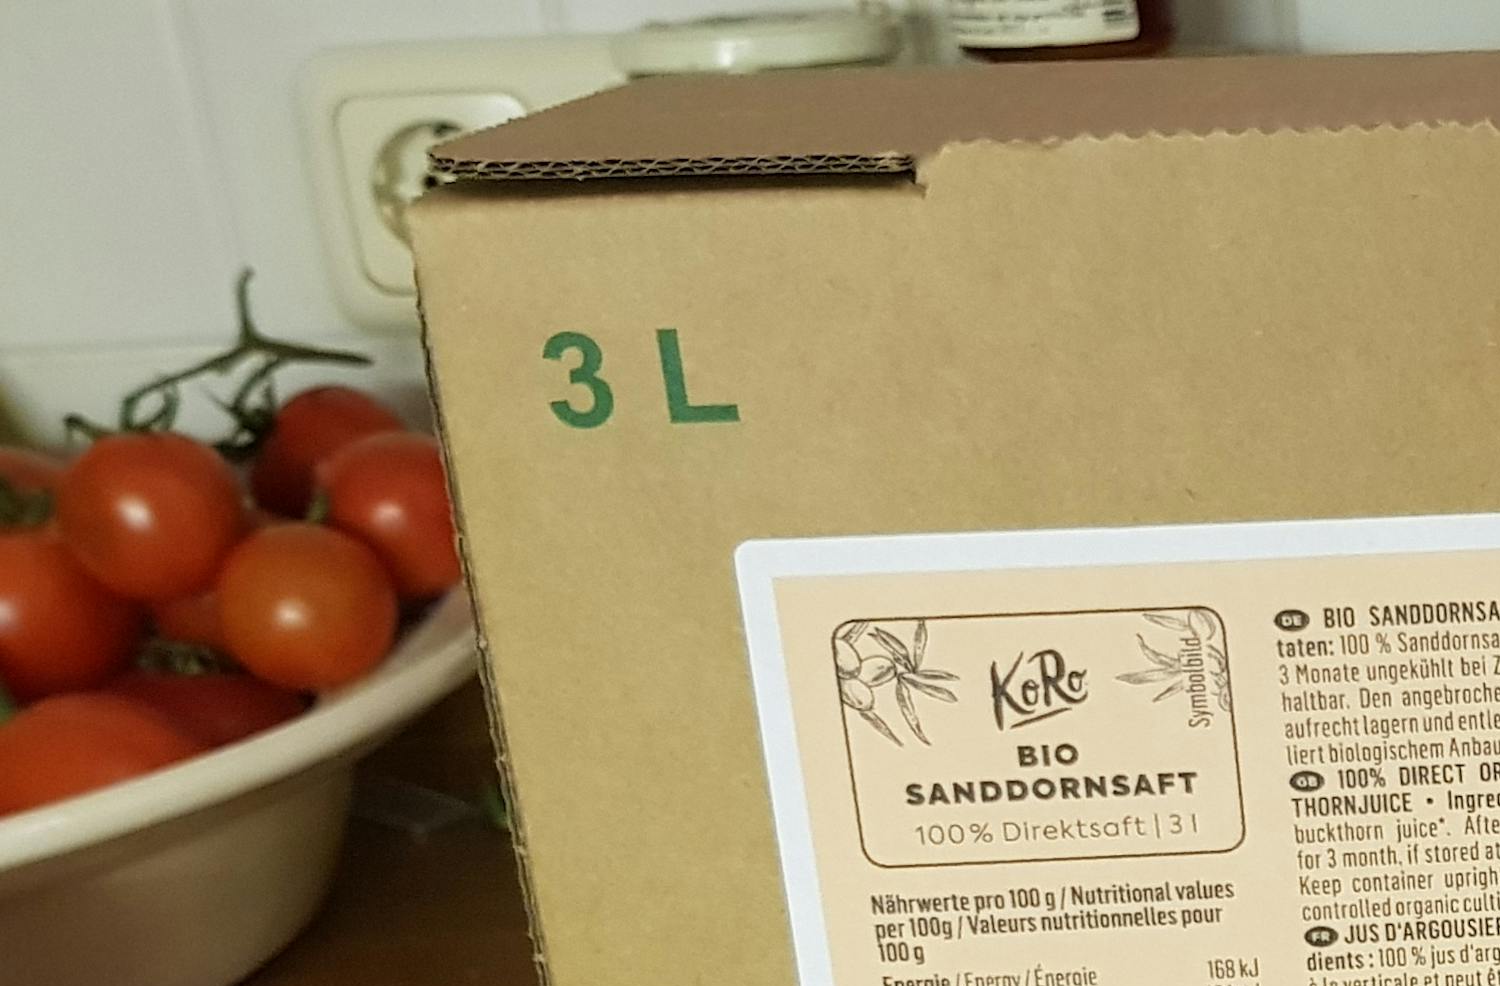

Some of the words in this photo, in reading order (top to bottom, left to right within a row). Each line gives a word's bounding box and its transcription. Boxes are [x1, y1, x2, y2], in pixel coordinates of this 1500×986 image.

[542, 331, 614, 429] 3
[656, 328, 741, 423] L
[1323, 606, 1355, 629] BIO
[1276, 638, 1335, 658] taten:
[1180, 636, 1212, 728] Symbolbild
[1295, 663, 1360, 685] Monate
[1366, 657, 1454, 685] ungekühlt
[1460, 655, 1486, 677] bei
[989, 648, 1089, 732] KoRo
[1281, 690, 1350, 712] haltbar.
[1359, 687, 1392, 709] Den
[1285, 716, 1360, 739] aufrecht
[1362, 714, 1419, 739] lagern
[1422, 710, 1454, 733] und
[1016, 743, 1079, 768] BIO
[905, 771, 1198, 806] SANDDORNSAFT
[1337, 767, 1386, 790] 100%
[1398, 763, 1466, 787] DIRECT
[1291, 792, 1413, 818] THORNJUICE
[915, 822, 994, 846] 100%
[1002, 815, 1148, 842] Direktsaft
[1169, 813, 1183, 835] 3
[1191, 813, 1197, 833] l
[1294, 821, 1384, 844] buckthorn
[1297, 850, 1321, 870] for
[1424, 840, 1480, 864] stored
[1299, 875, 1342, 898] Keep
[1352, 870, 1434, 893] container
[870, 894, 970, 915] Nährwerte
[973, 894, 1005, 919] pro
[1008, 887, 1041, 909] 100
[1070, 881, 1173, 906] Nutritional
[1174, 880, 1235, 901] values
[1302, 897, 1392, 922] controlled
[1395, 893, 1459, 920] organic
[874, 923, 905, 948] per
[908, 916, 953, 940] 100g
[966, 908, 1037, 935] Valeurs
[1040, 906, 1178, 932] nutritionnelles
[1181, 907, 1223, 929] pour
[1344, 923, 1380, 945] JUS
[876, 937, 910, 963] 100
[1430, 944, 1456, 970] jus
[1207, 959, 1236, 979] 168
[1238, 957, 1259, 978] kJ
